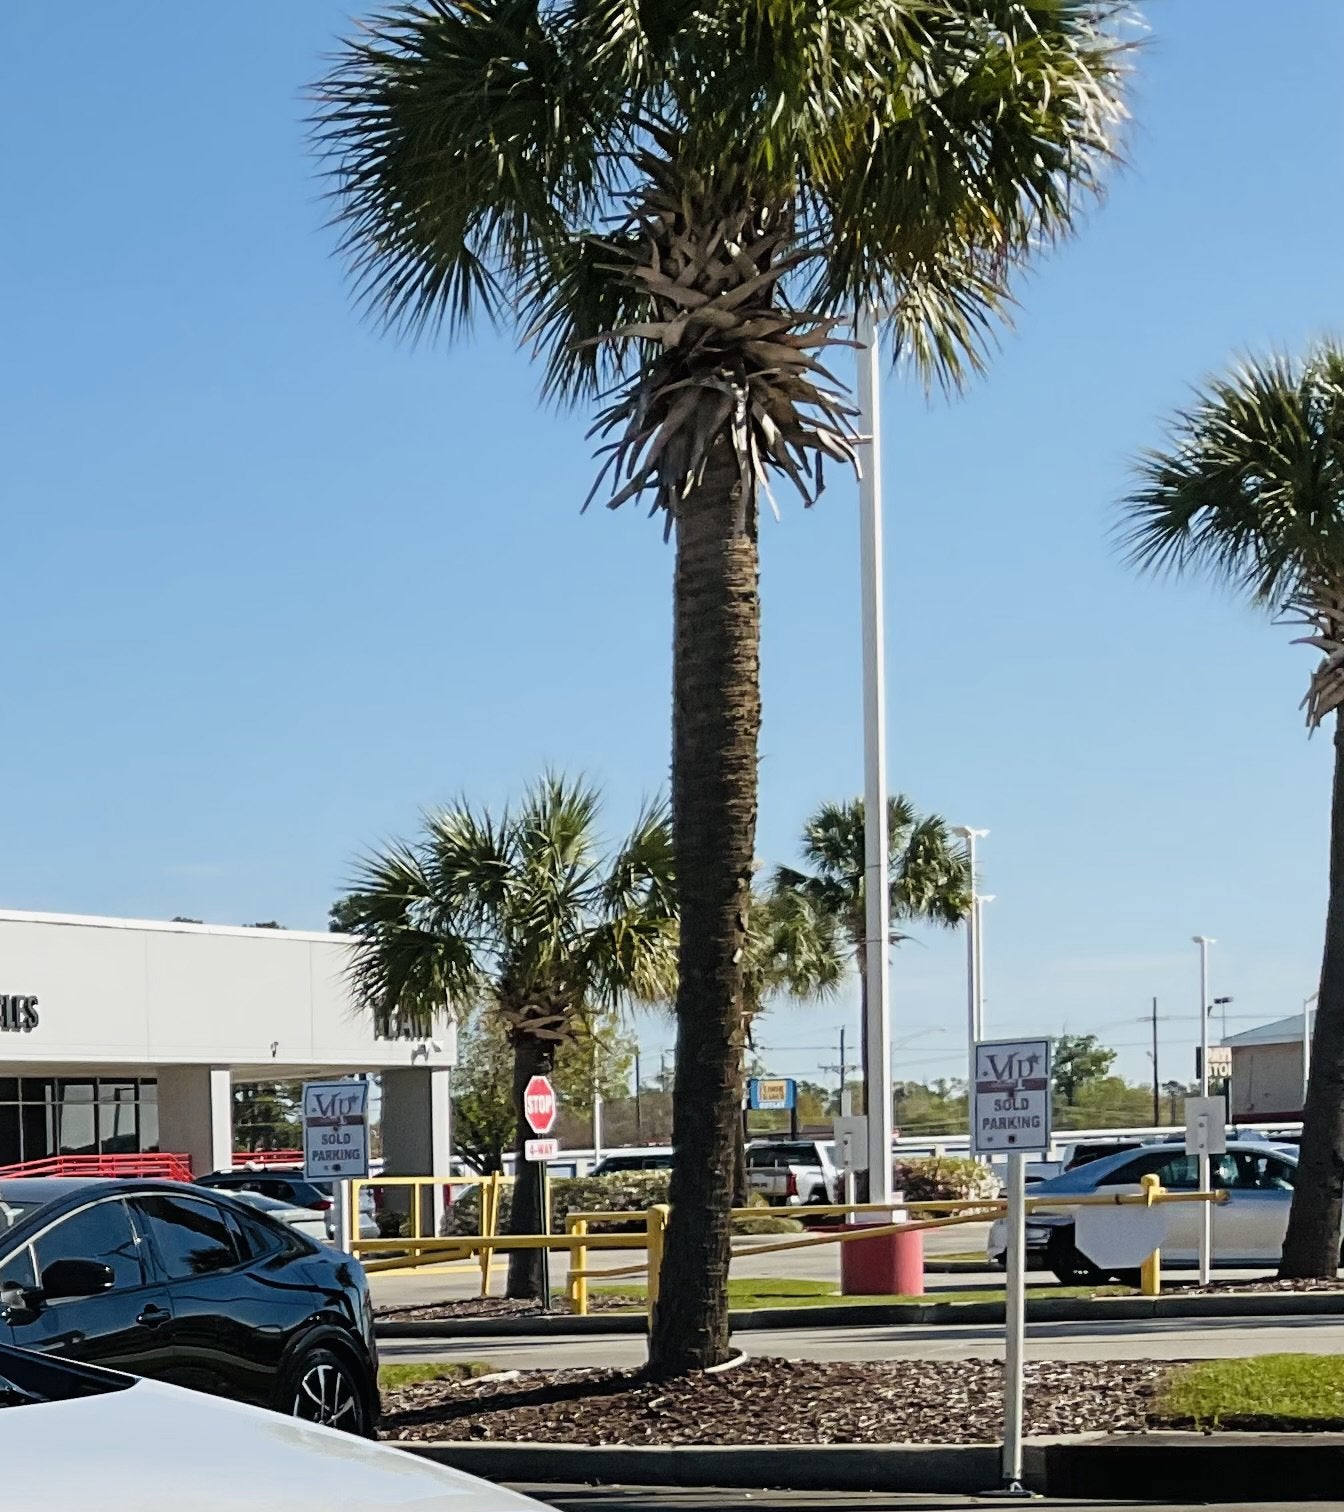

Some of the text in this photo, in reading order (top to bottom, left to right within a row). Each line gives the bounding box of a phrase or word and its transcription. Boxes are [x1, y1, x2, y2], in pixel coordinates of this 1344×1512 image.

[527, 1094, 553, 1114] STOP
[994, 1098, 1030, 1112] SOLD
[982, 1115, 1041, 1130] PARKING
[321, 1133, 351, 1145] SOLD
[312, 1149, 361, 1161] PARKING
